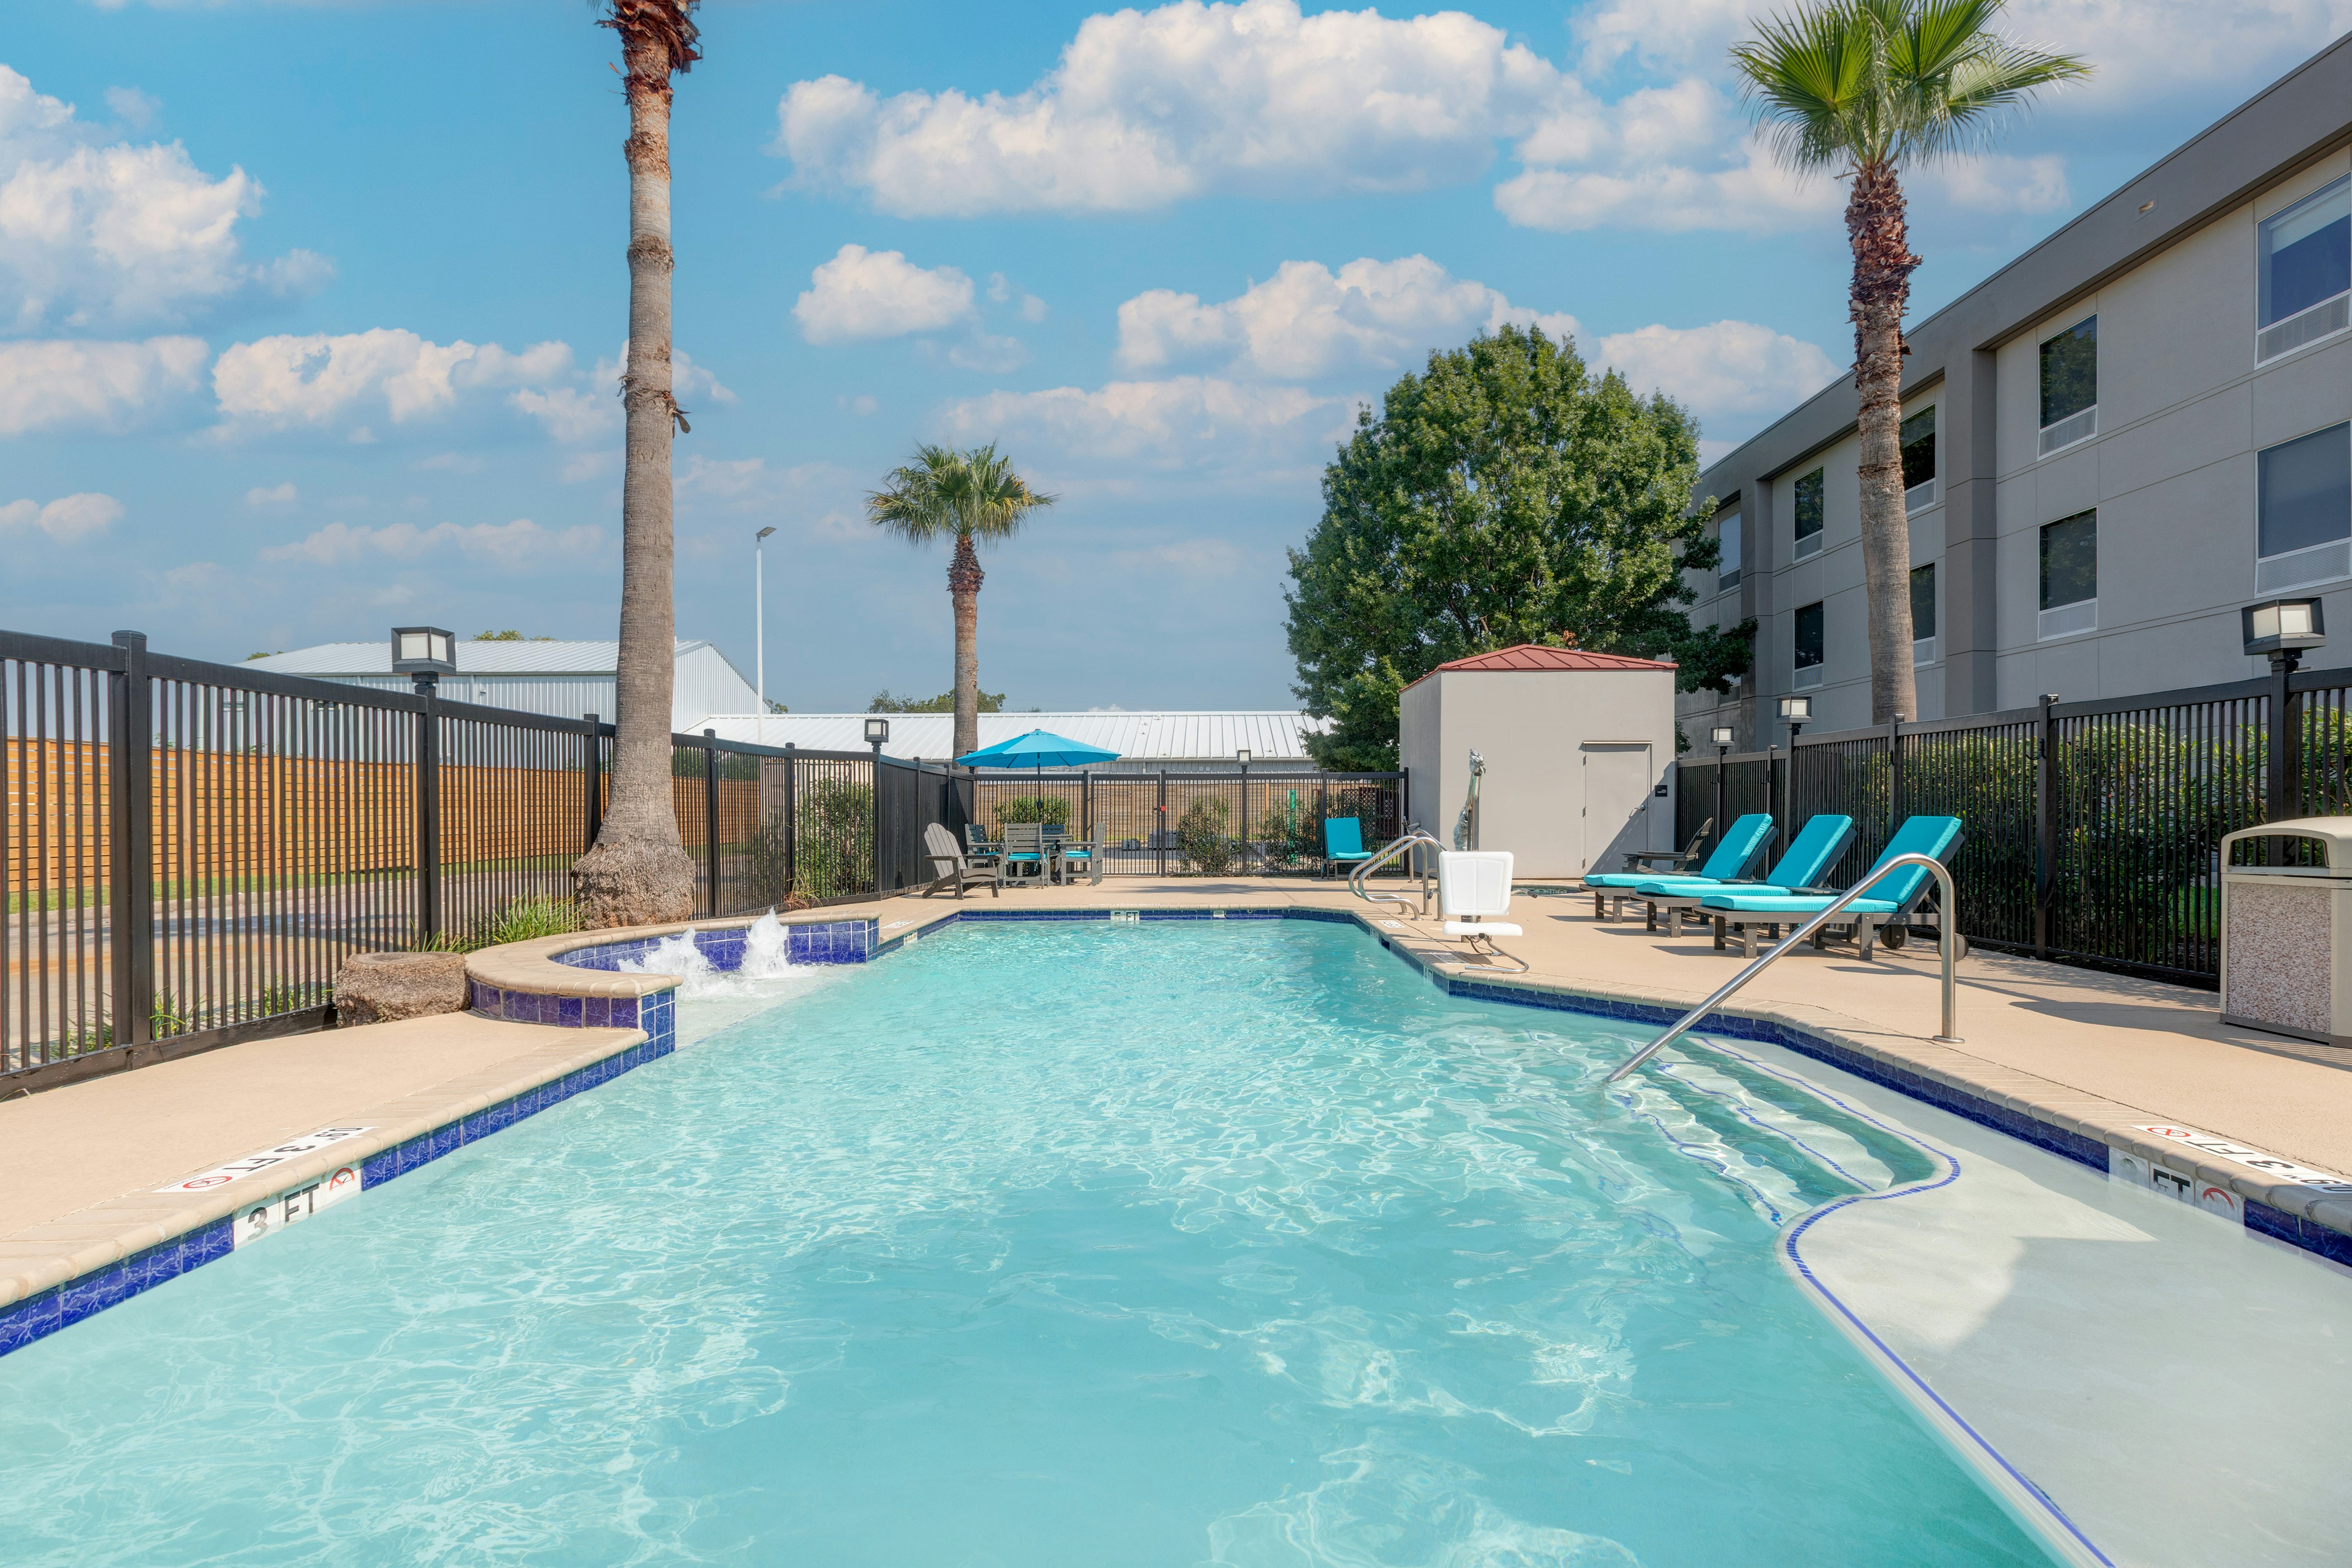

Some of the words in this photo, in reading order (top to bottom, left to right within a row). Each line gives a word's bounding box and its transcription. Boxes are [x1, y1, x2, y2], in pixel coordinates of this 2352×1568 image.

[1126, 912, 1138, 923] FT
[2184, 1140, 2255, 1155] FT
[222, 1157, 284, 1172] FT
[2246, 1160, 2295, 1169] 3
[2153, 1168, 2190, 1201] FT
[248, 1206, 268, 1240] 3
[285, 1183, 319, 1223] FT
